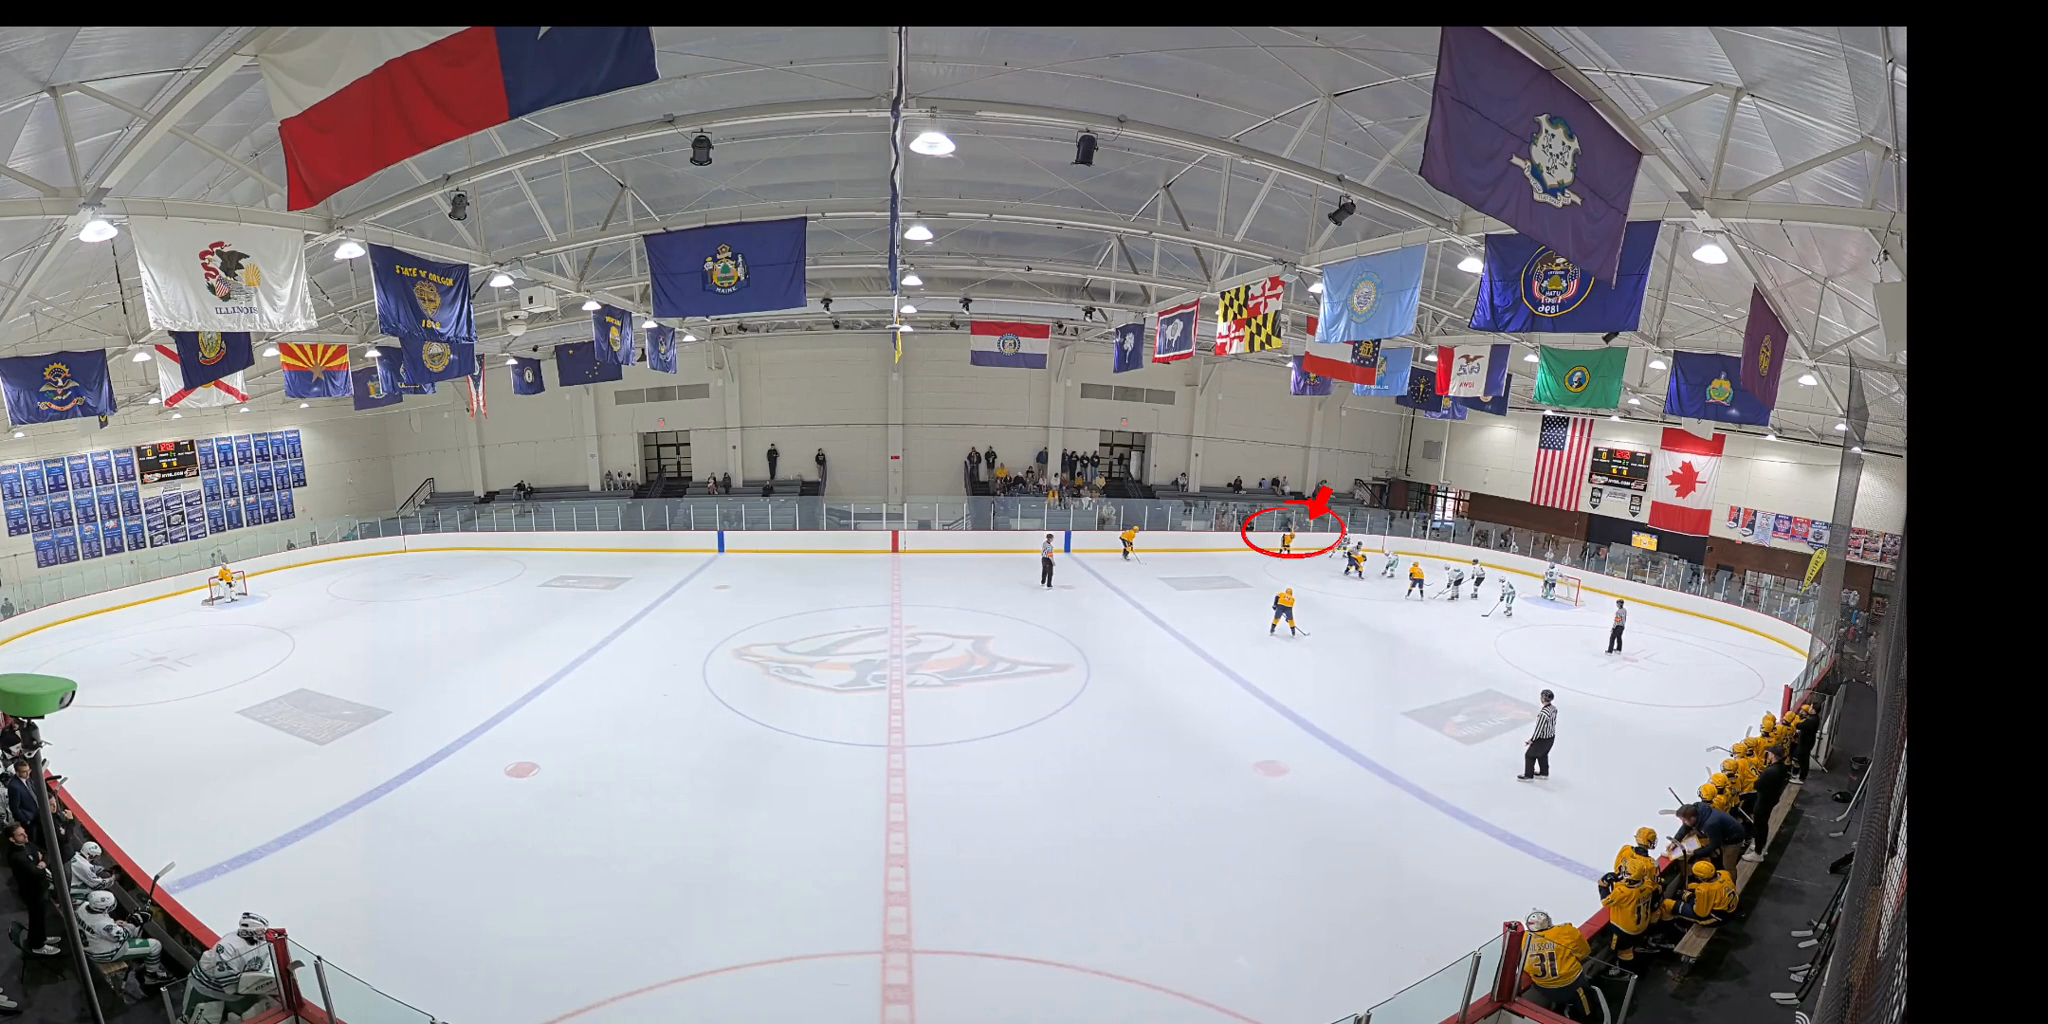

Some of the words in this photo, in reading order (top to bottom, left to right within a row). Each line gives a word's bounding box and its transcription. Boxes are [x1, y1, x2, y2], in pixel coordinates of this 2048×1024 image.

[395, 265, 418, 277] STATE
[428, 273, 454, 287] OREGON
[716, 286, 737, 294] MAINE
[214, 306, 259, 315] ILLINOIS
[1528, 951, 1559, 979] 31
